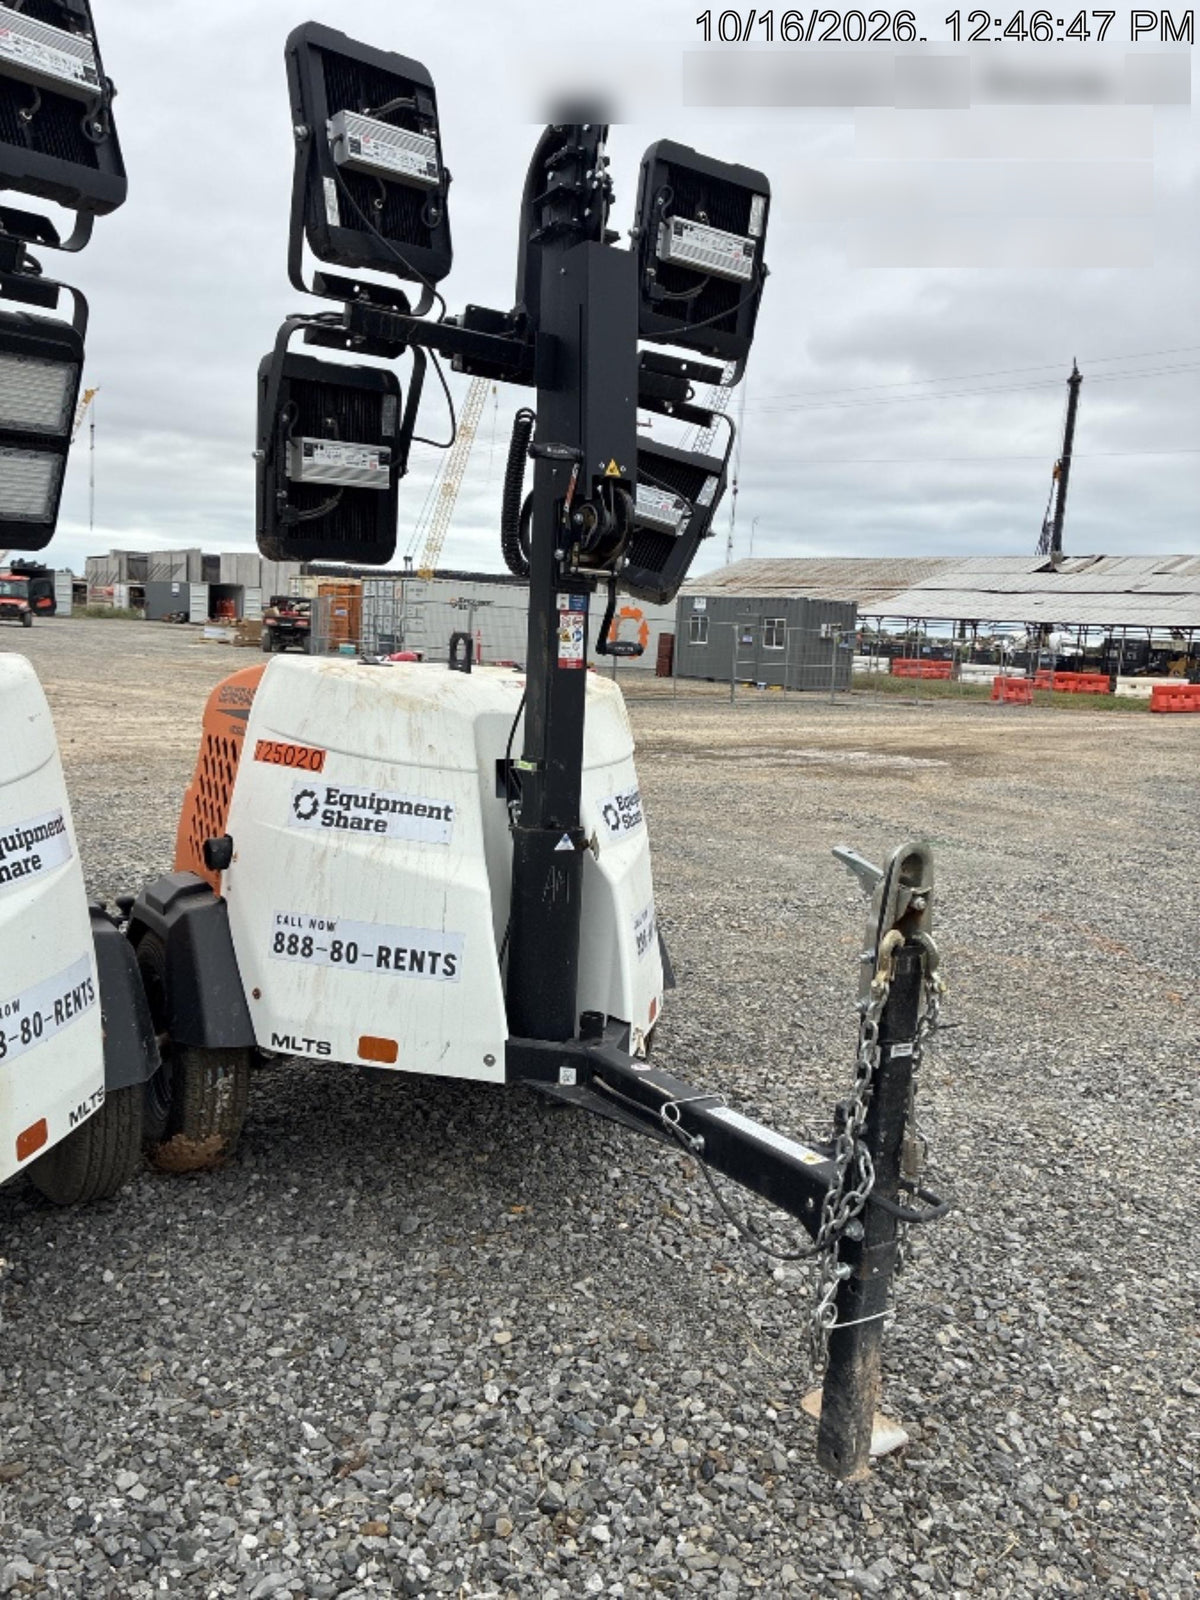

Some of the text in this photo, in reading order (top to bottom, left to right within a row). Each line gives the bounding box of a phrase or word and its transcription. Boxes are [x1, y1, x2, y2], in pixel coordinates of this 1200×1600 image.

[325, 788, 453, 822] Equipment
[321, 809, 388, 833] Share
[0, 814, 66, 860] uipment
[0, 854, 42, 883] hare
[276, 914, 336, 932] CALL NOW
[273, 931, 457, 977] 888-80-RENTS
[0, 999, 20, 1019] OW
[271, 1032, 332, 1055] MLTS
